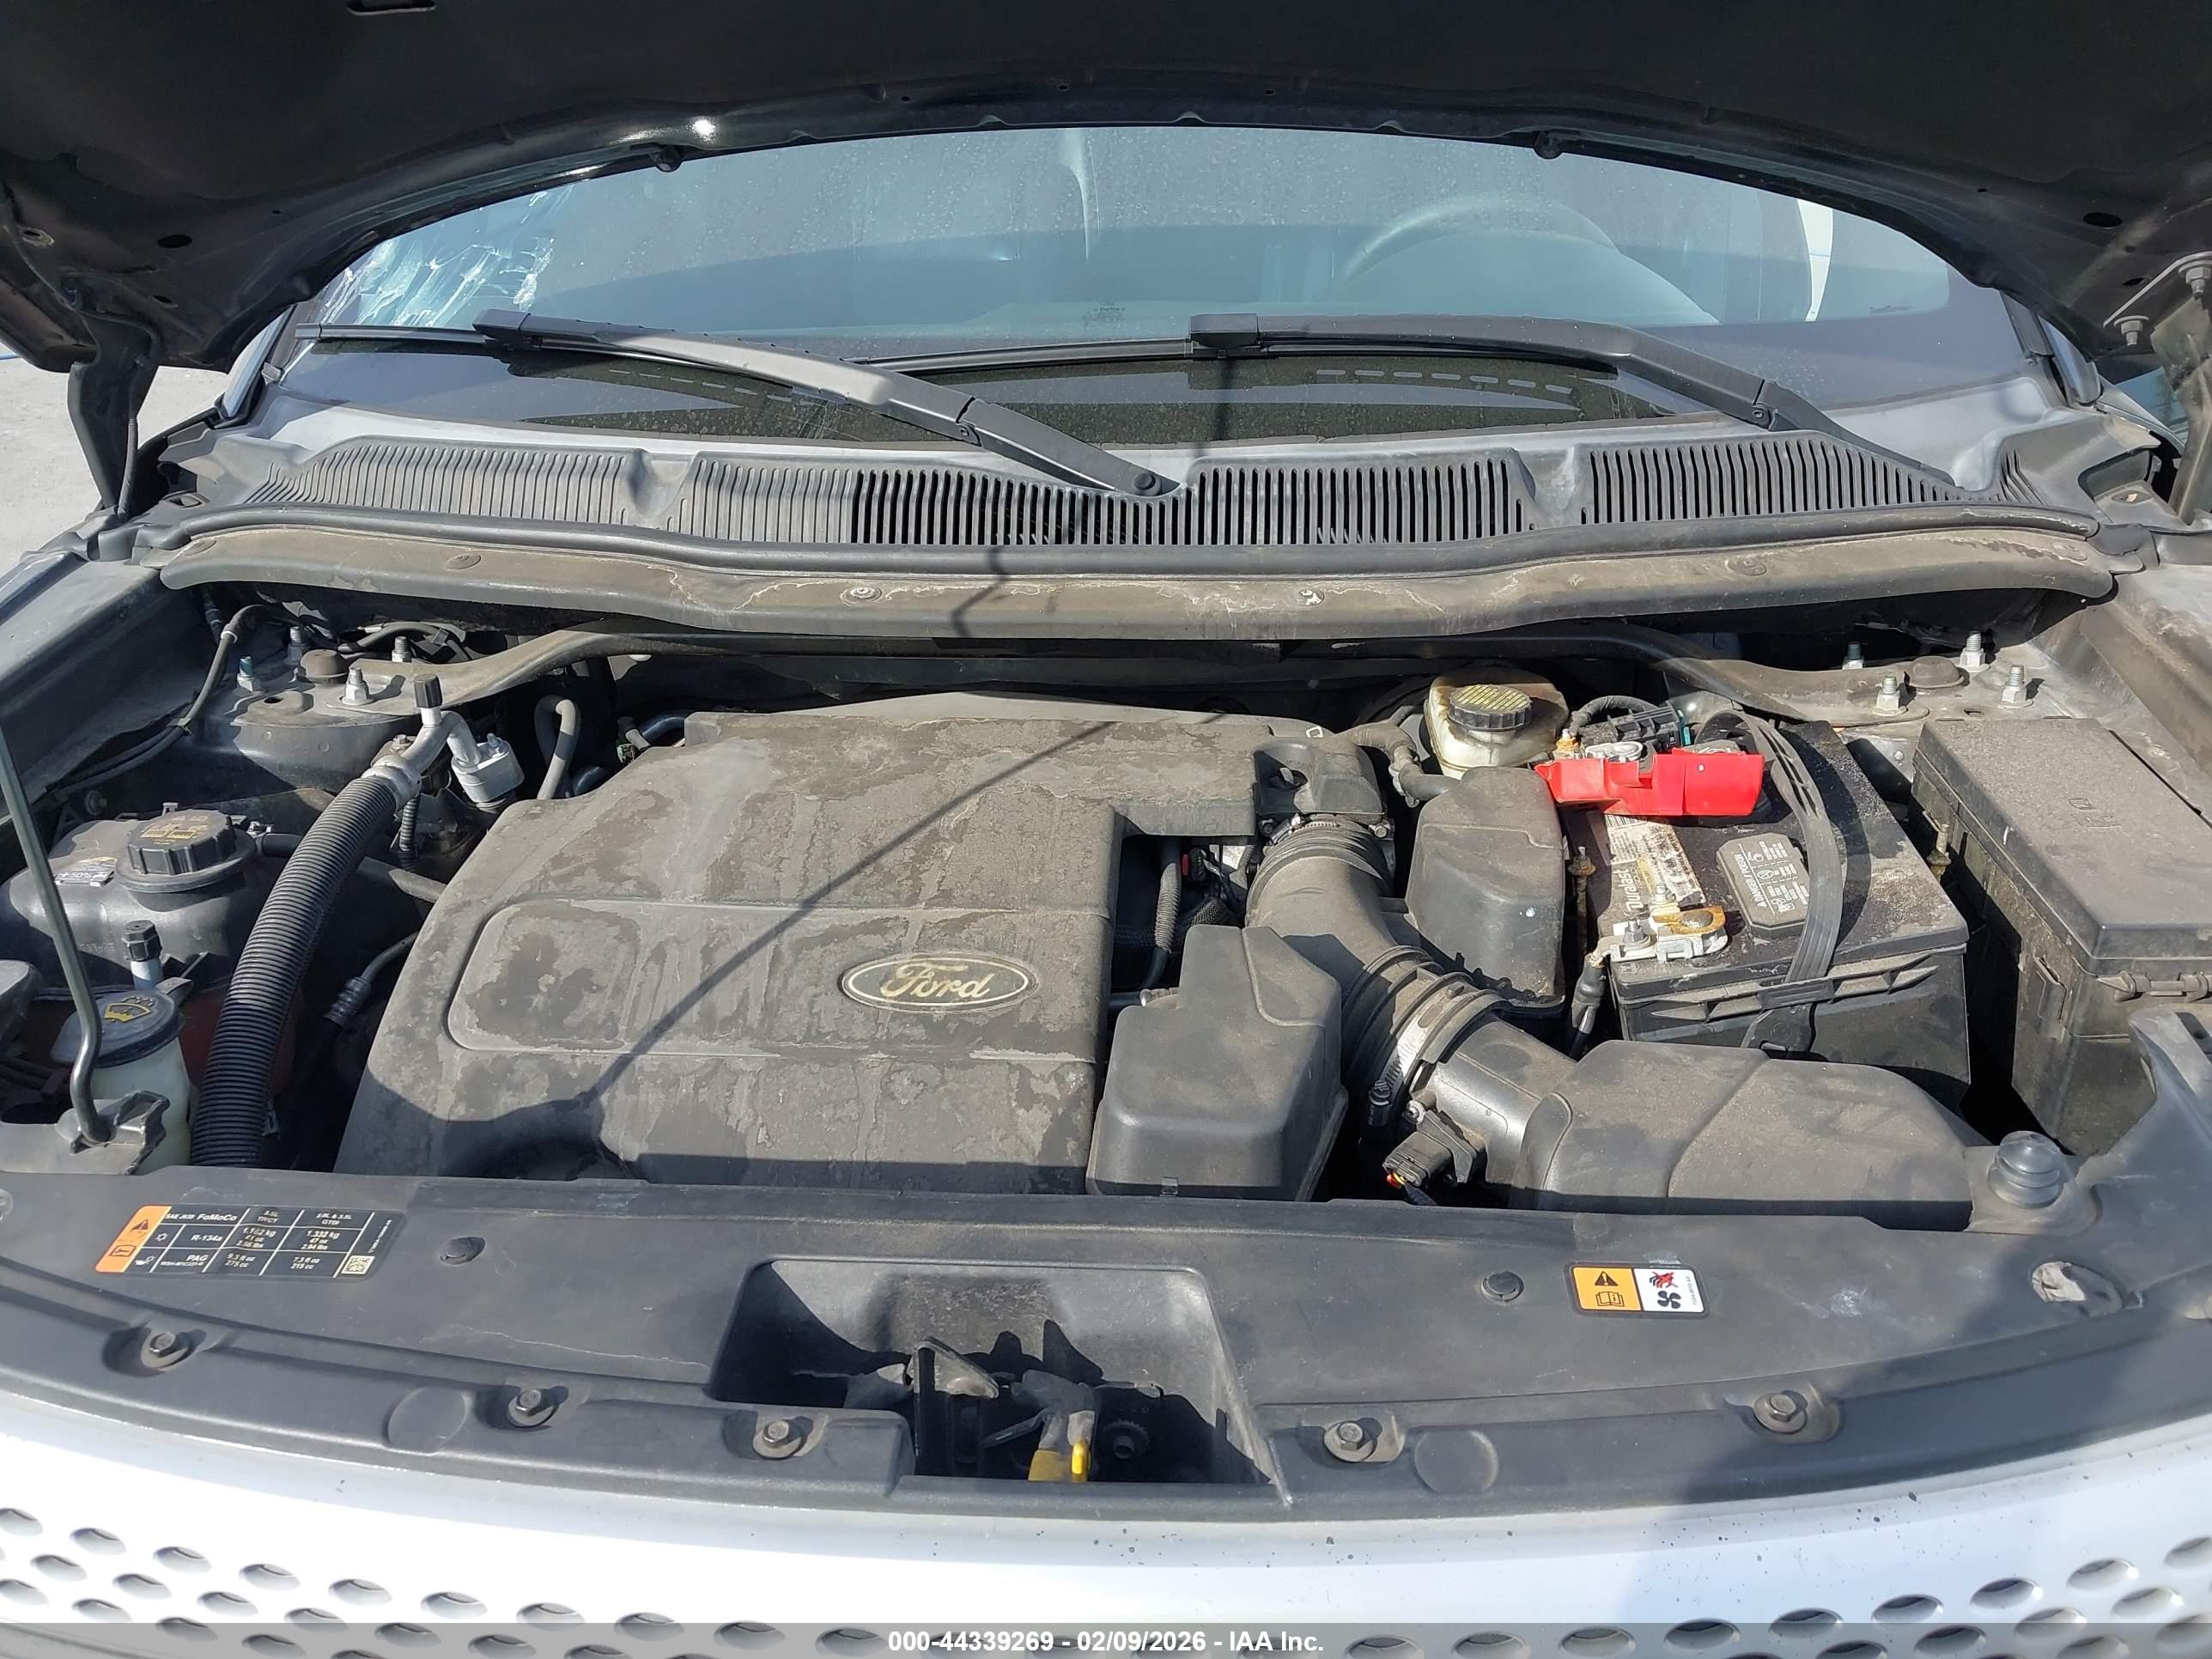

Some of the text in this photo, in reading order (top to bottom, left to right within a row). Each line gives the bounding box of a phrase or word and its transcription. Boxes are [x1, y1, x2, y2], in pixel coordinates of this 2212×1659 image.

[1613, 868, 1644, 912] Duralast
[1745, 878, 1765, 902] DANGER
[879, 962, 996, 998] Ford
[265, 1229, 276, 1237] kg
[328, 1231, 340, 1240] kg
